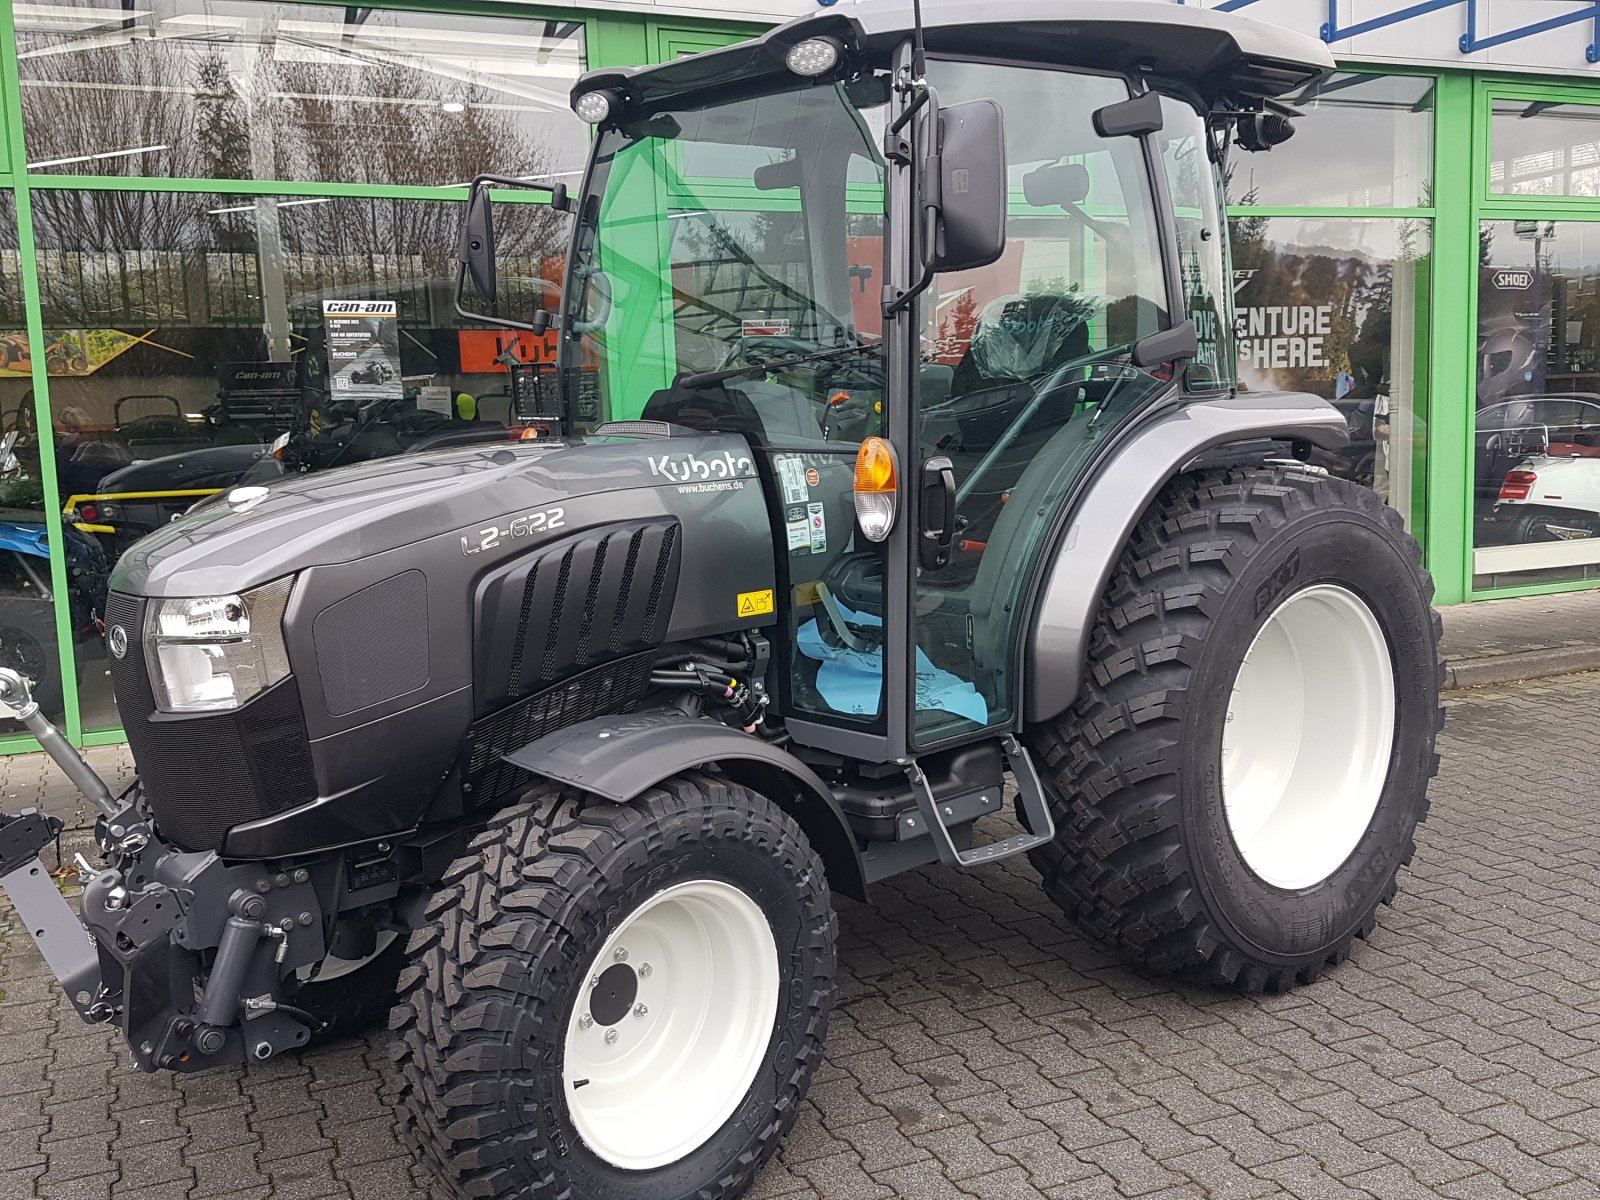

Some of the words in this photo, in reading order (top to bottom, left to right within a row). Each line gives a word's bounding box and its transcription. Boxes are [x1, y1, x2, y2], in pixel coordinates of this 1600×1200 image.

[1498, 274, 1528, 287] SHOEI
[326, 303, 393, 313] can-am
[1253, 336, 1330, 369] HERE.
[648, 451, 756, 482] Kubota
[677, 480, 744, 494] www.buchens.de
[461, 507, 566, 557] L2-622
[1254, 552, 1299, 615] BKT
[773, 946, 808, 1076] TOYO
